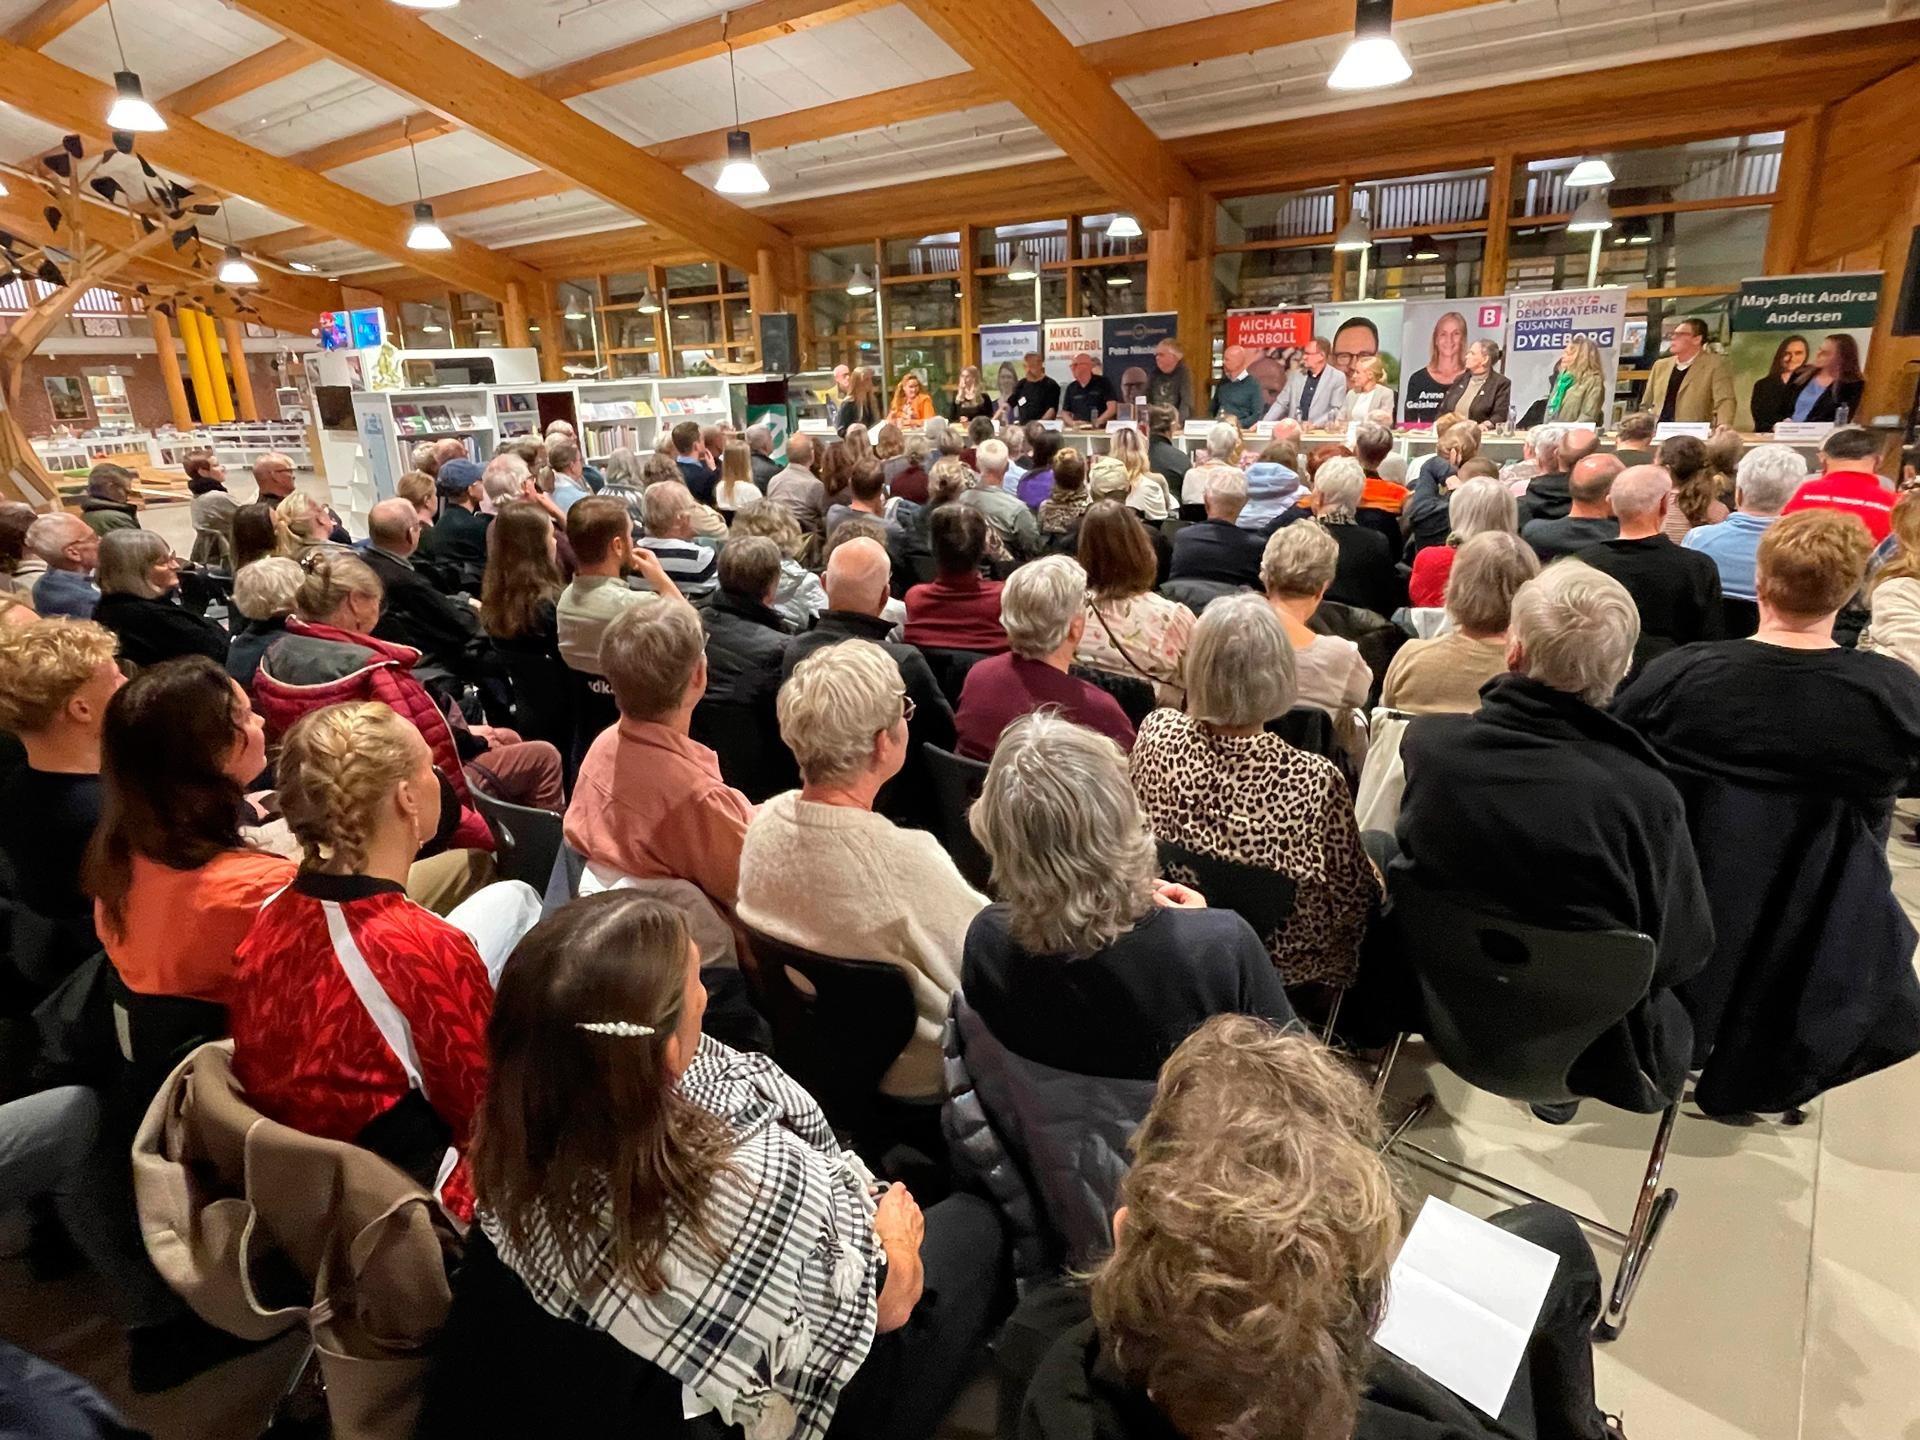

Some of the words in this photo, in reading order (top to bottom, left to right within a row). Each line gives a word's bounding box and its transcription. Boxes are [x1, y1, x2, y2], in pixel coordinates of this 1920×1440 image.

[1516, 296, 1584, 309] DANMARKS
[1741, 293, 1816, 308] May-Britt
[1818, 290, 1878, 303] Andrea
[1483, 309, 1496, 325] B
[1516, 304, 1618, 318] DEMOKRATERNE
[1766, 311, 1842, 324] Andersen
[1240, 318, 1296, 331] MICHAEL
[1517, 320, 1570, 331] SUSANNE
[1050, 327, 1082, 338] MIKKEL
[1238, 332, 1296, 345] HARBØLL
[1108, 347, 1129, 356] Peter
[1419, 391, 1444, 399] Anne
[1406, 400, 1439, 409] Geisler
